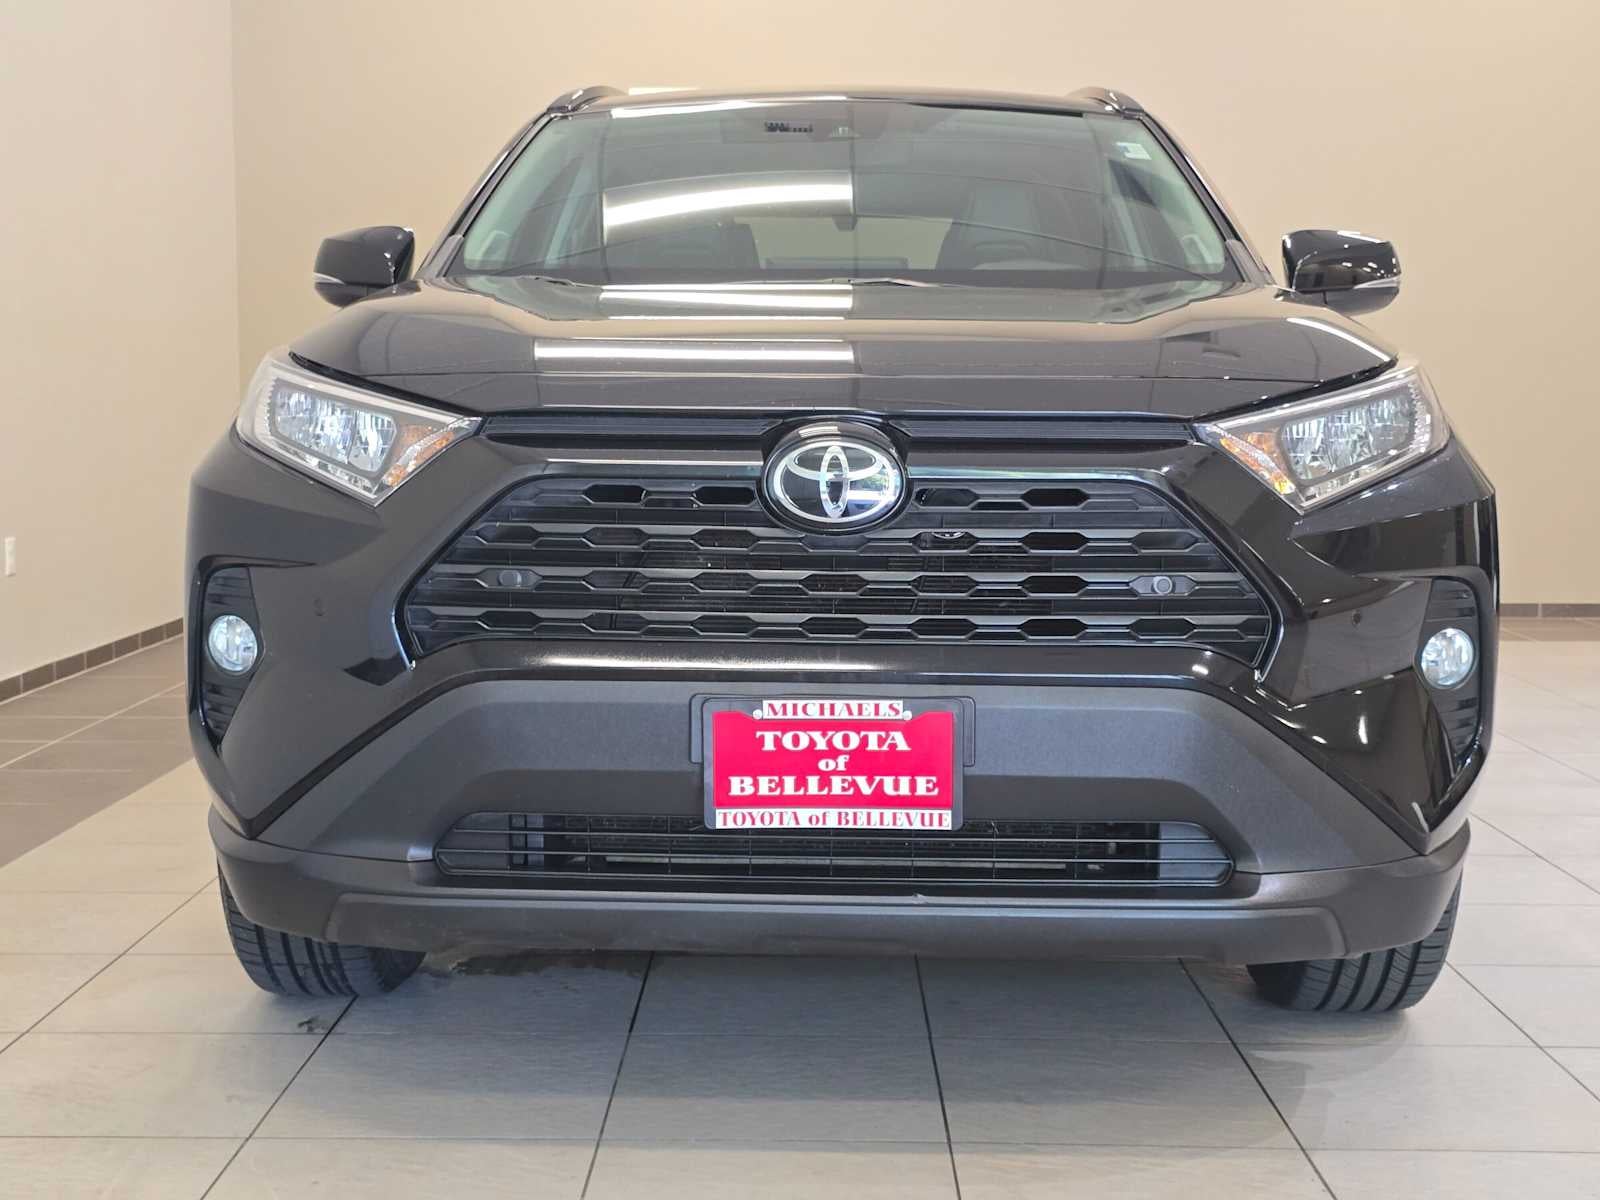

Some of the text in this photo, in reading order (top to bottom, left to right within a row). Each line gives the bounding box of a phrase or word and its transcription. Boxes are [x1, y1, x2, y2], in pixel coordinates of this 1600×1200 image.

[766, 703, 901, 717] MICHAELS
[756, 731, 911, 751] TOYOTA
[818, 755, 849, 772] of
[728, 776, 939, 796] BELLEVUE
[718, 811, 950, 828] TOYOTA of BELLEVUE
